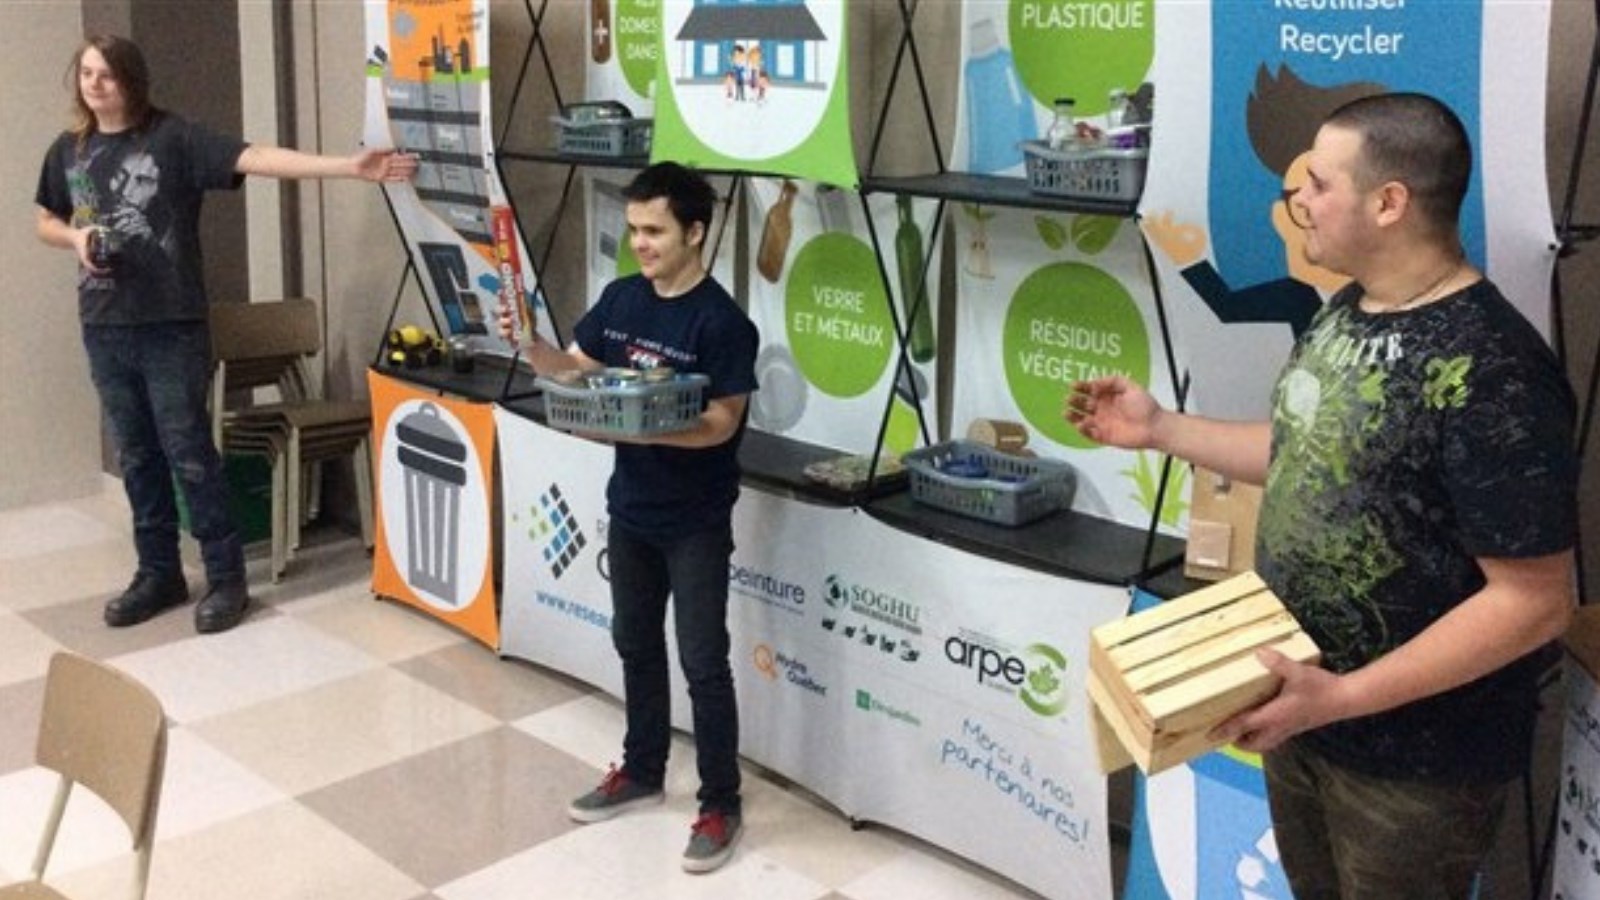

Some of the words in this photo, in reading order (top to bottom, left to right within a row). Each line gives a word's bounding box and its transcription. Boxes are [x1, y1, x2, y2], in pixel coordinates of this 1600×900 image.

[1021, 1, 1145, 31] PLASTIQUE
[1279, 23, 1404, 61] Recycler
[811, 284, 865, 314] VERRE
[793, 312, 815, 334] ET
[816, 313, 885, 347] MÉTAUX
[1030, 316, 1123, 358] RÉSIDUS
[851, 583, 921, 623] SOGHU
[944, 635, 1026, 684] arpe
[962, 718, 1013, 766] Merci
